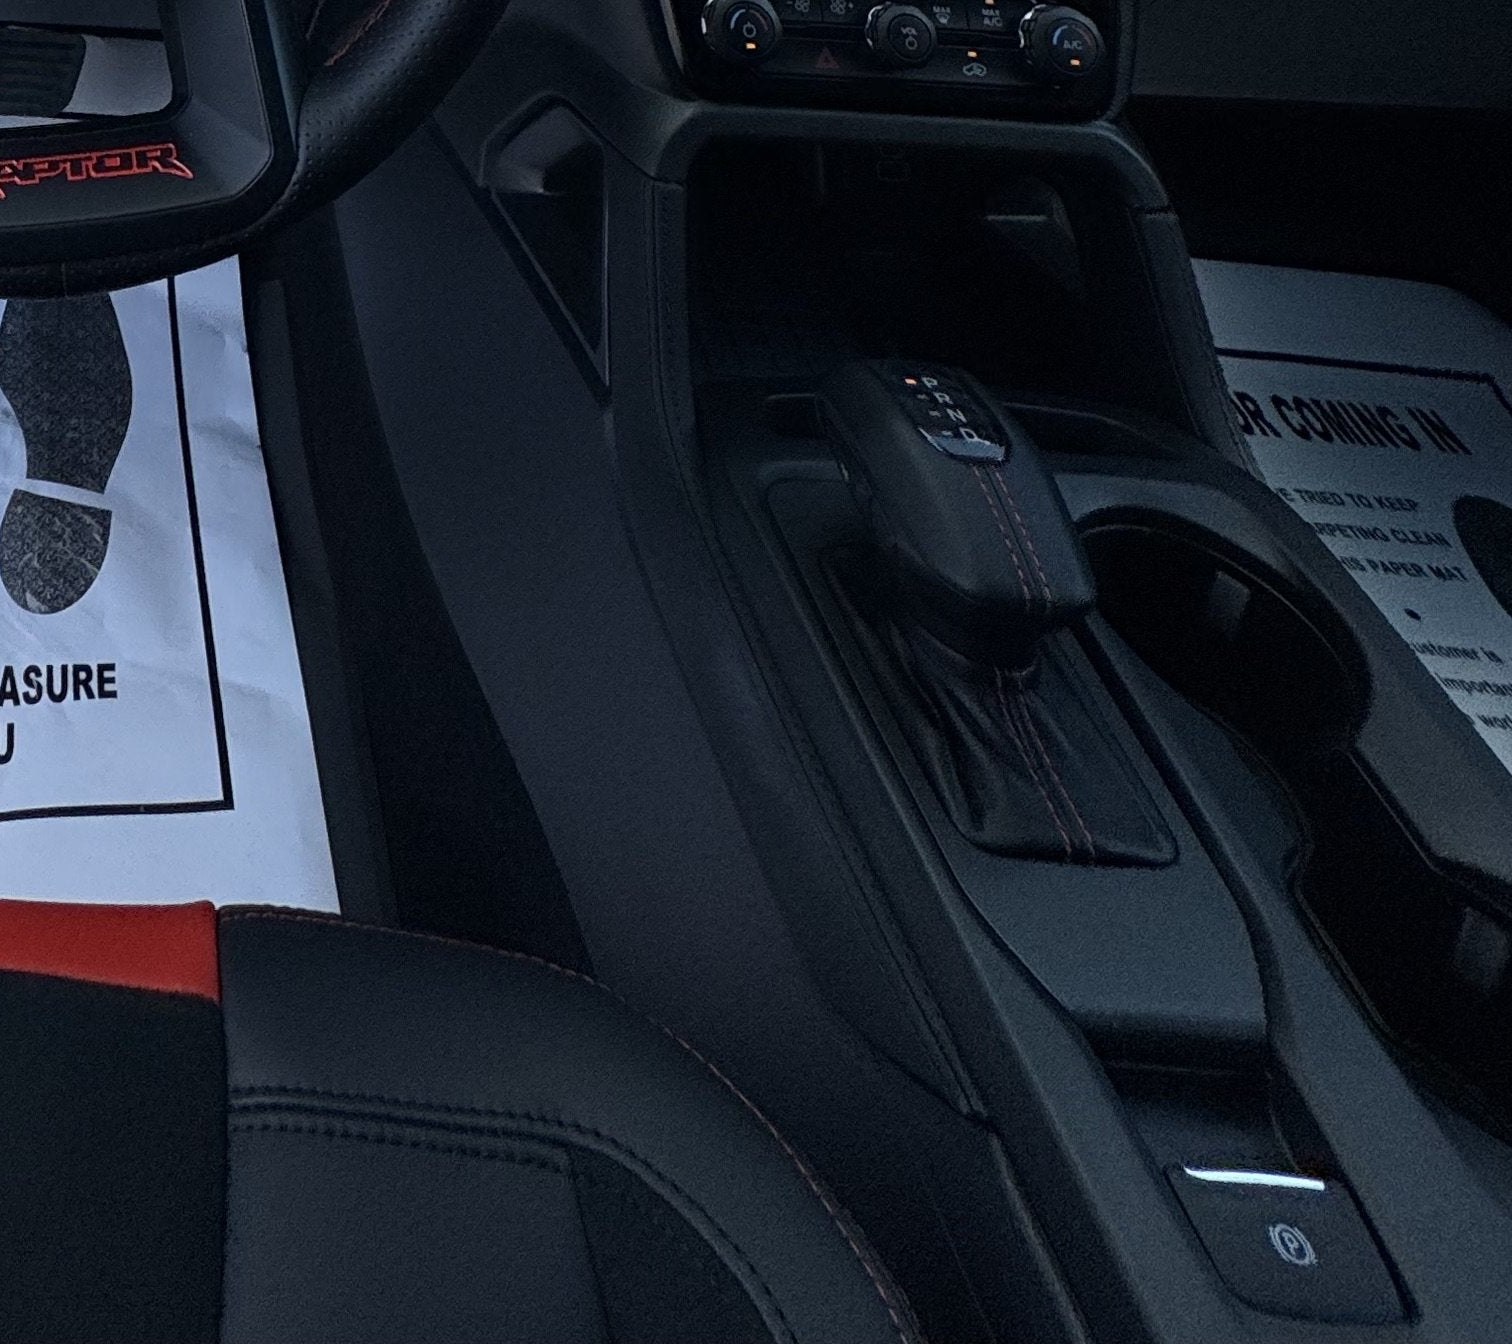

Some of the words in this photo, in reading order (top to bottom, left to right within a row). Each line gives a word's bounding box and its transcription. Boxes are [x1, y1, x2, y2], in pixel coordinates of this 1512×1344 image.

[983, 16, 1003, 27] A/C
[900, 26, 919, 36] VOL
[1063, 39, 1083, 50] A/C
[932, 391, 954, 405] R
[945, 408, 968, 423] N
[1271, 393, 1422, 452] COMING
[1405, 405, 1473, 456] IN
[1294, 488, 1346, 507] TRIED
[1344, 493, 1374, 510] TO
[1373, 495, 1419, 513] KEEP
[1391, 527, 1453, 548] CLEAN
[1366, 558, 1430, 578] PAPER
[1427, 563, 1469, 582] MAT
[1480, 646, 1505, 665] is
